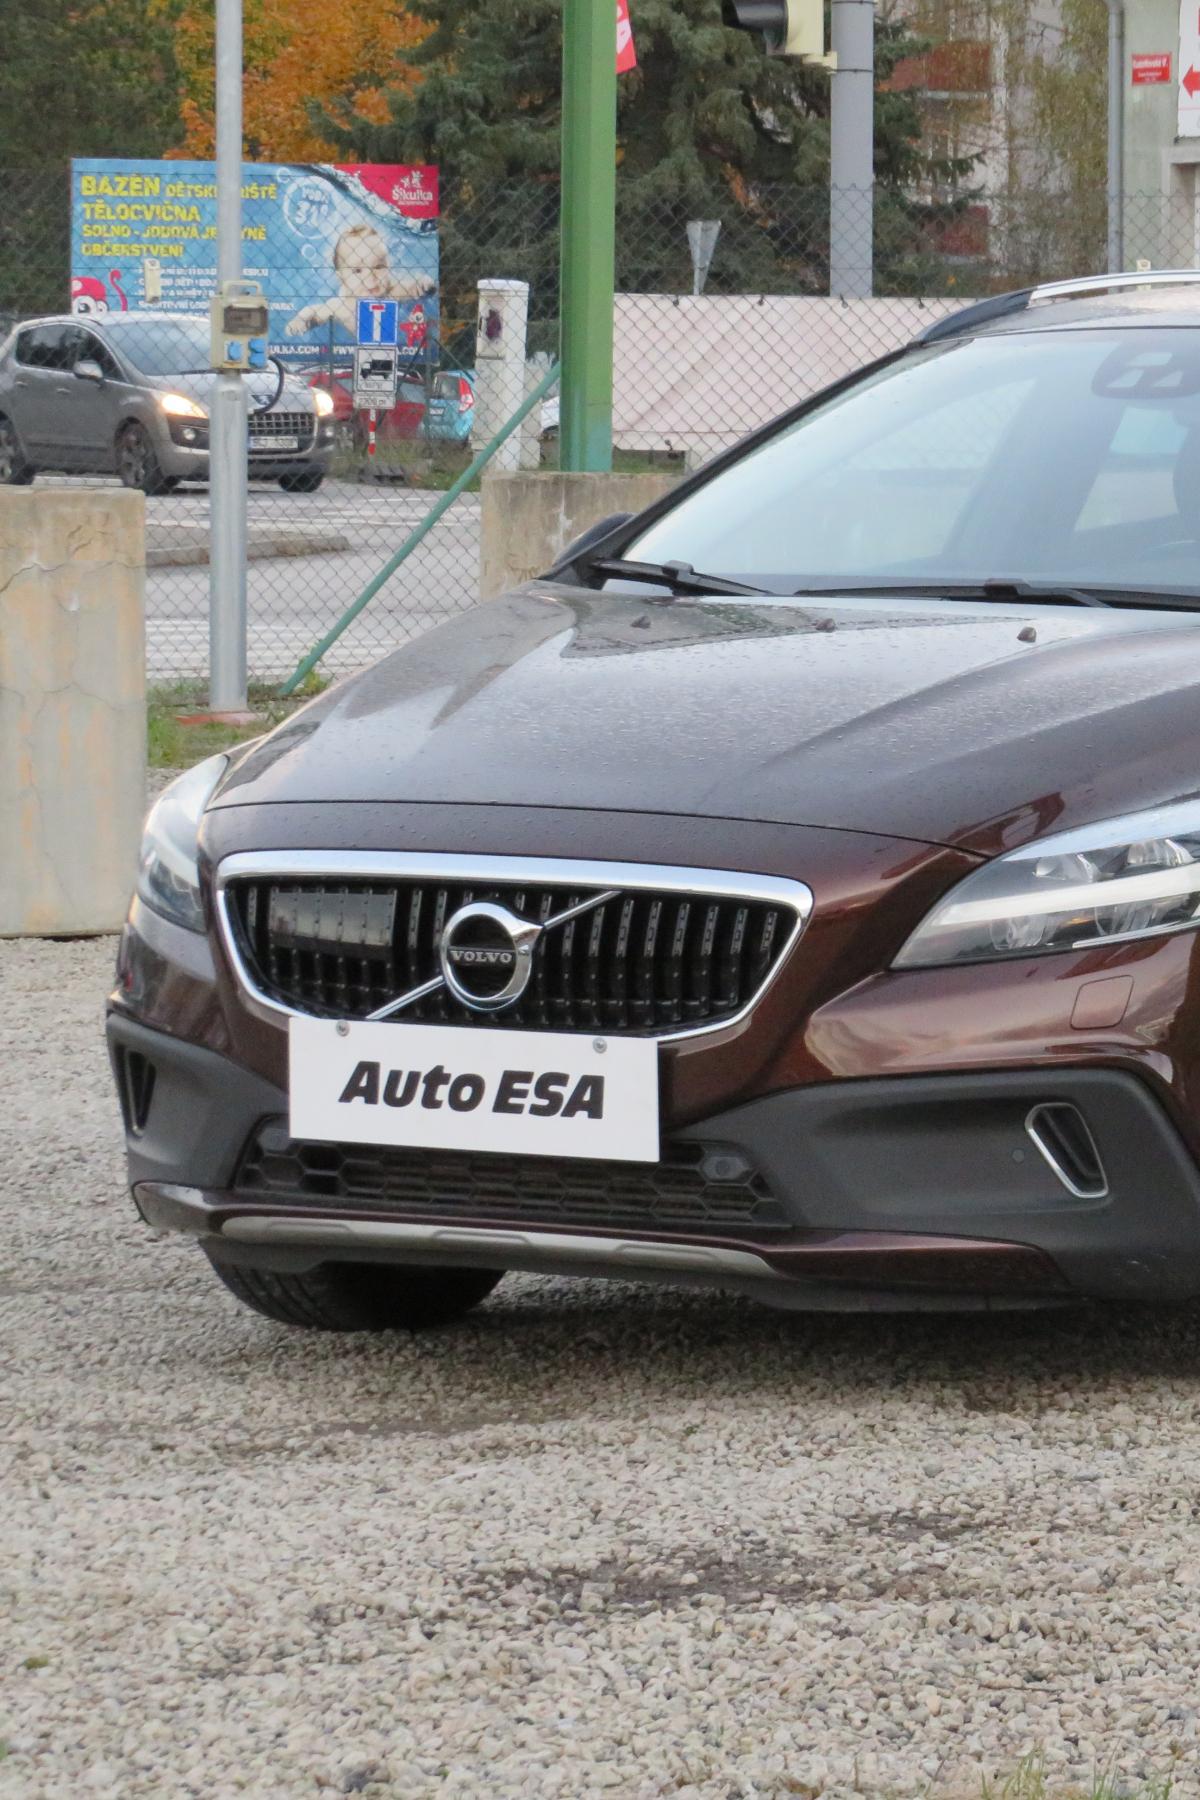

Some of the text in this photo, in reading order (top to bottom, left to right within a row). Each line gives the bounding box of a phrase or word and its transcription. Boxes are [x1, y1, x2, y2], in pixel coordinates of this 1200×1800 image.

[81, 173, 161, 196] BAZÉN
[166, 182, 217, 198] DĚTSK
[82, 199, 201, 221] TĚLOCVIČNA
[450, 950, 512, 963] VOLVO
[338, 1060, 605, 1119] Auto ESA
